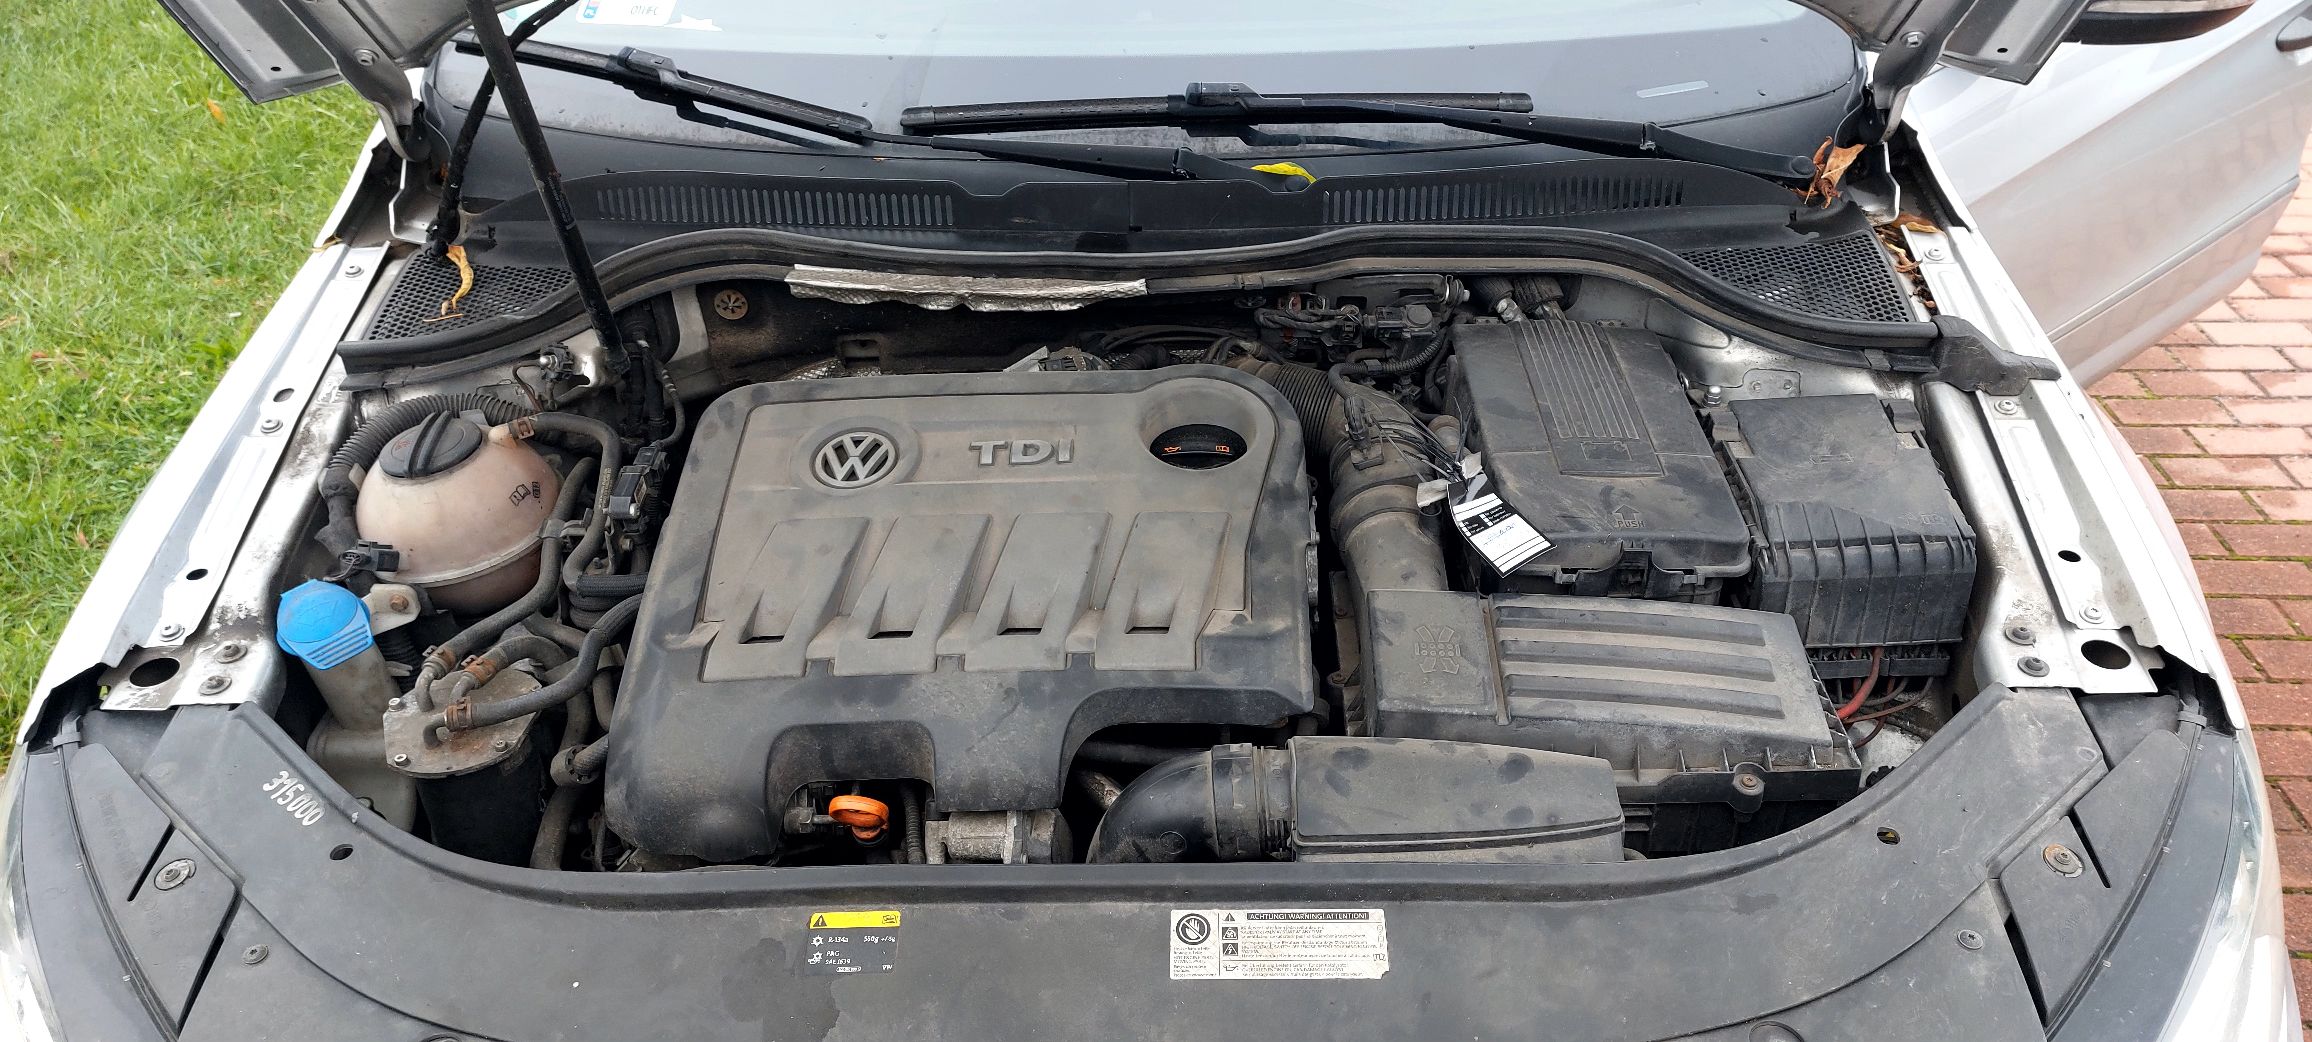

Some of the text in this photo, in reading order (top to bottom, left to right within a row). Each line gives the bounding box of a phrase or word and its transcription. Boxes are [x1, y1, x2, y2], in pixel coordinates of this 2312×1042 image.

[816, 431, 895, 487] VW
[969, 438, 1075, 467] TDI
[1617, 520, 1645, 528] PUSH
[262, 770, 326, 826] 315000
[863, 935, 879, 944] 550g
